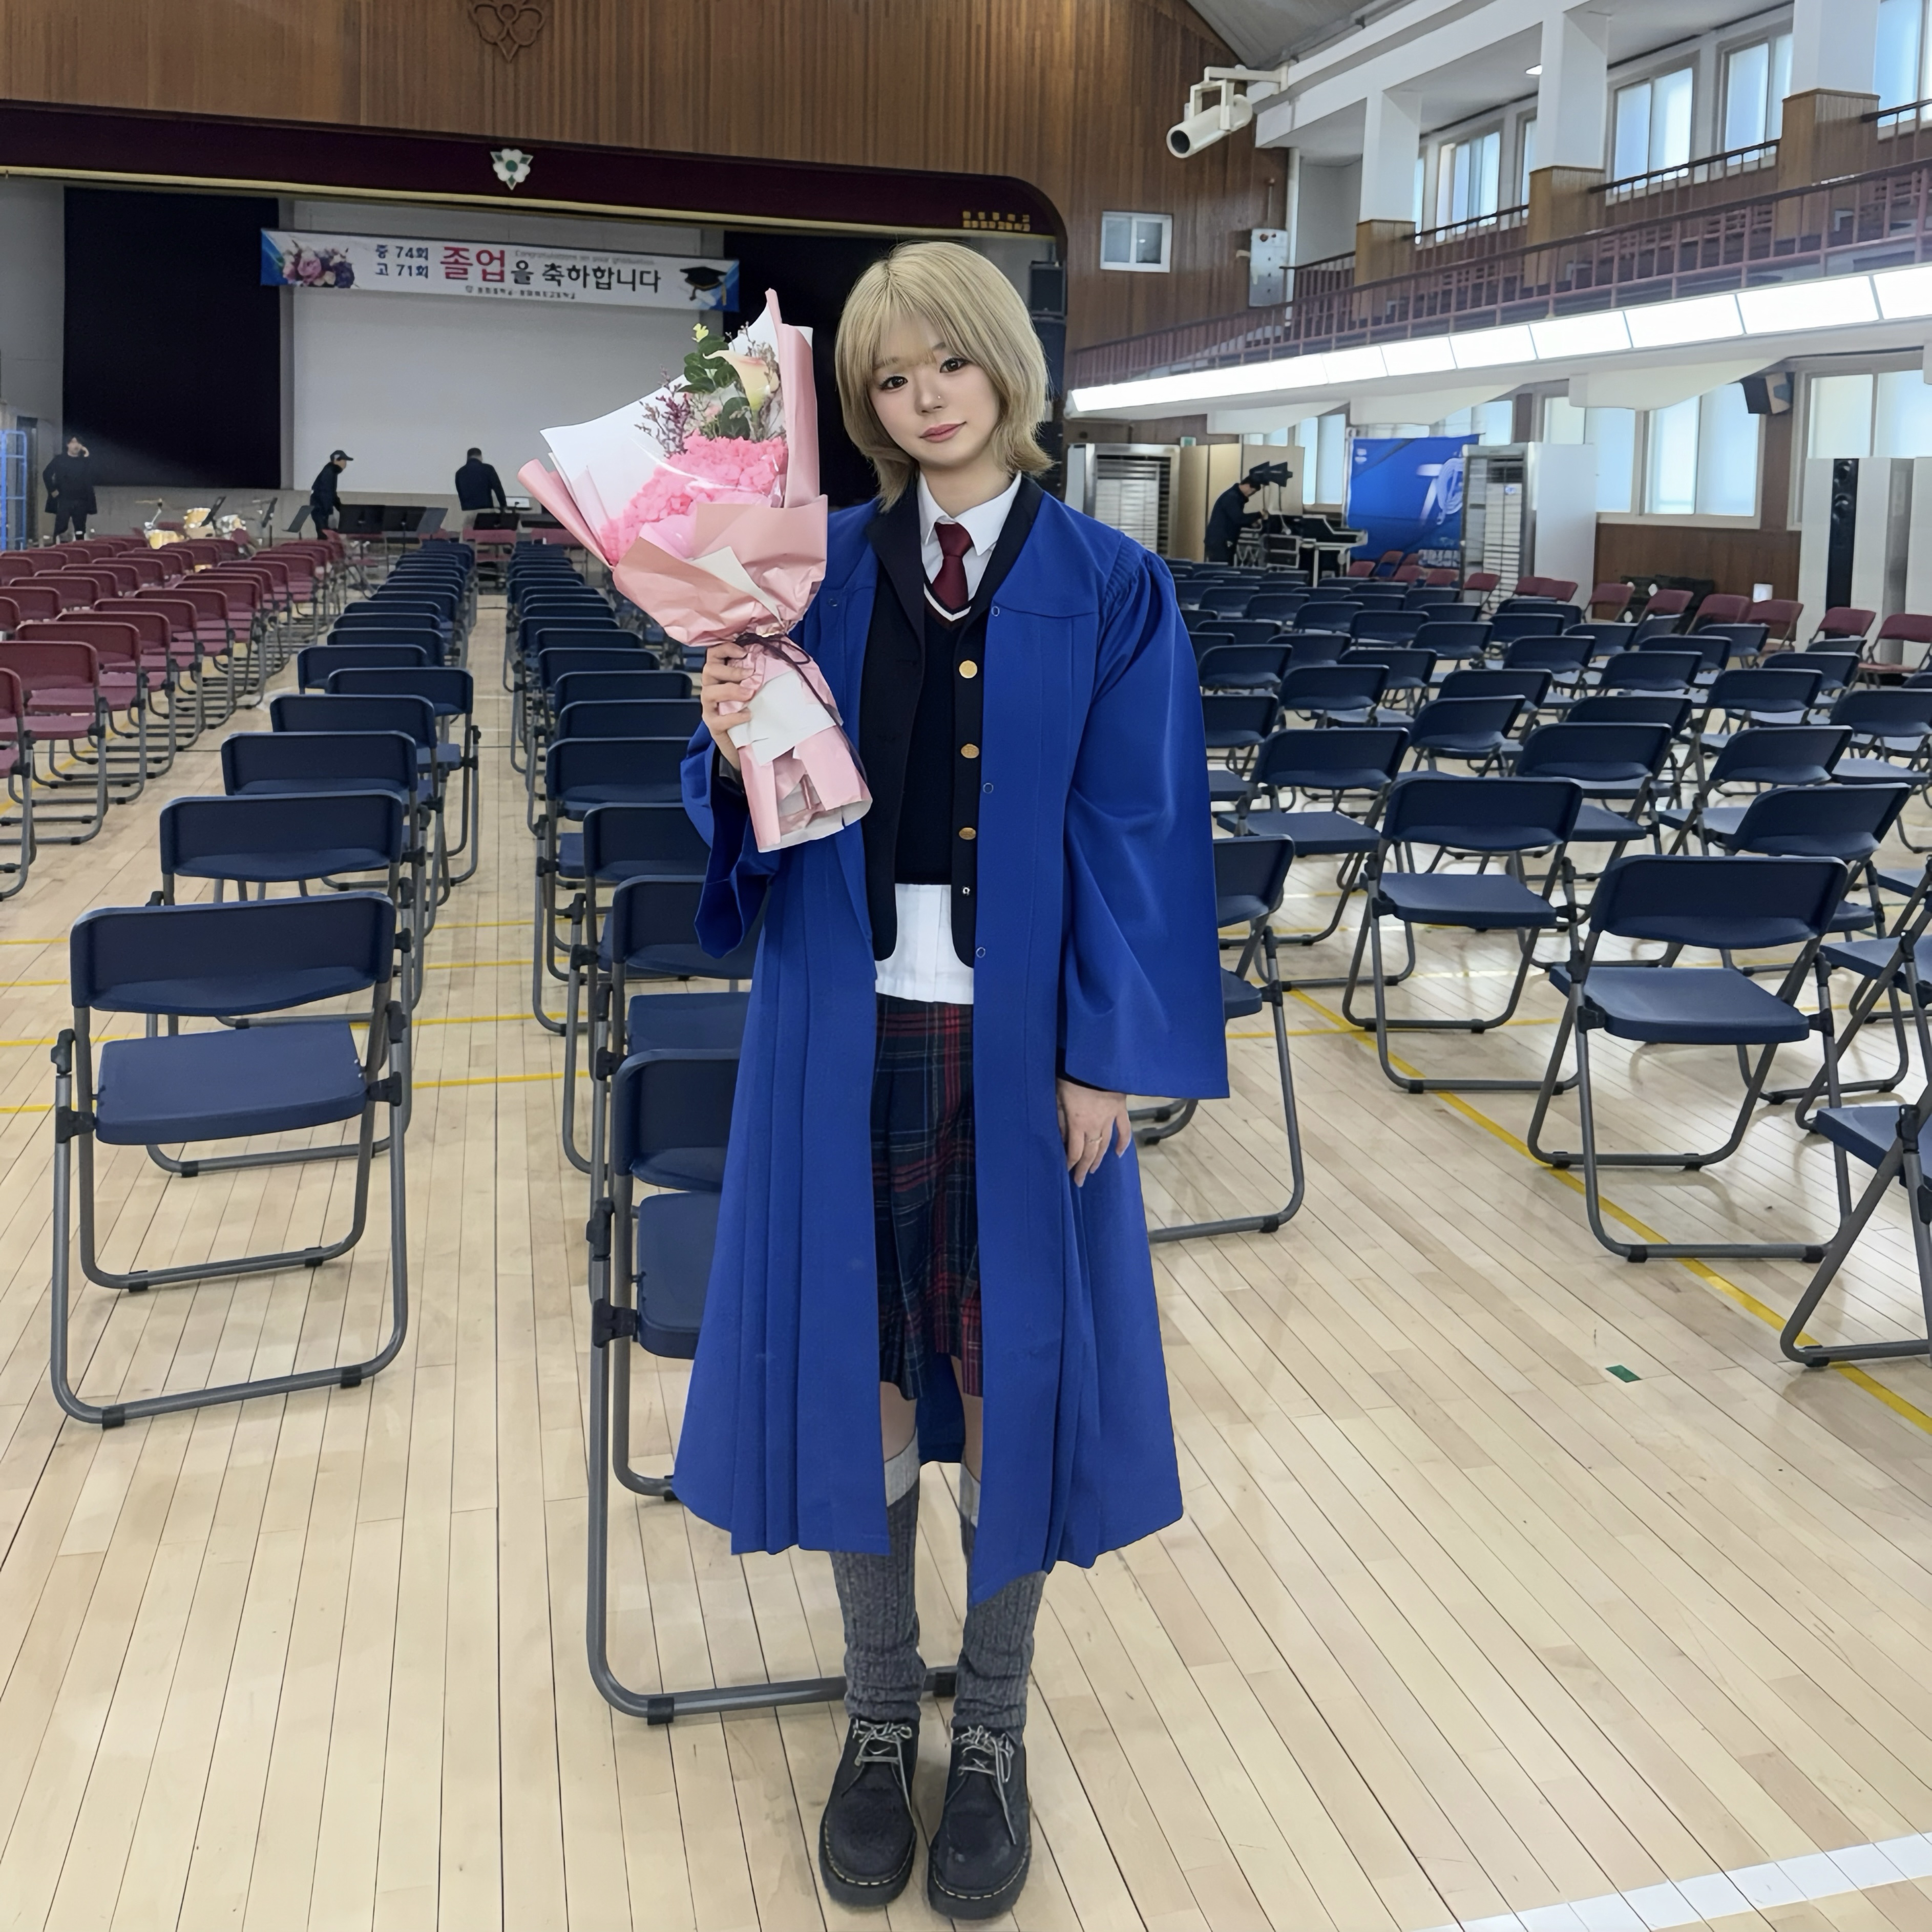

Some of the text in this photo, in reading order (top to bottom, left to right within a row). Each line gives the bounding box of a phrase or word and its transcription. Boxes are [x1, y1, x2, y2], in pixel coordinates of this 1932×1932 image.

[375, 244, 429, 261] 중 74회
[375, 263, 429, 279] 고 71회
[440, 246, 661, 293] 졸업을 축하합니다
